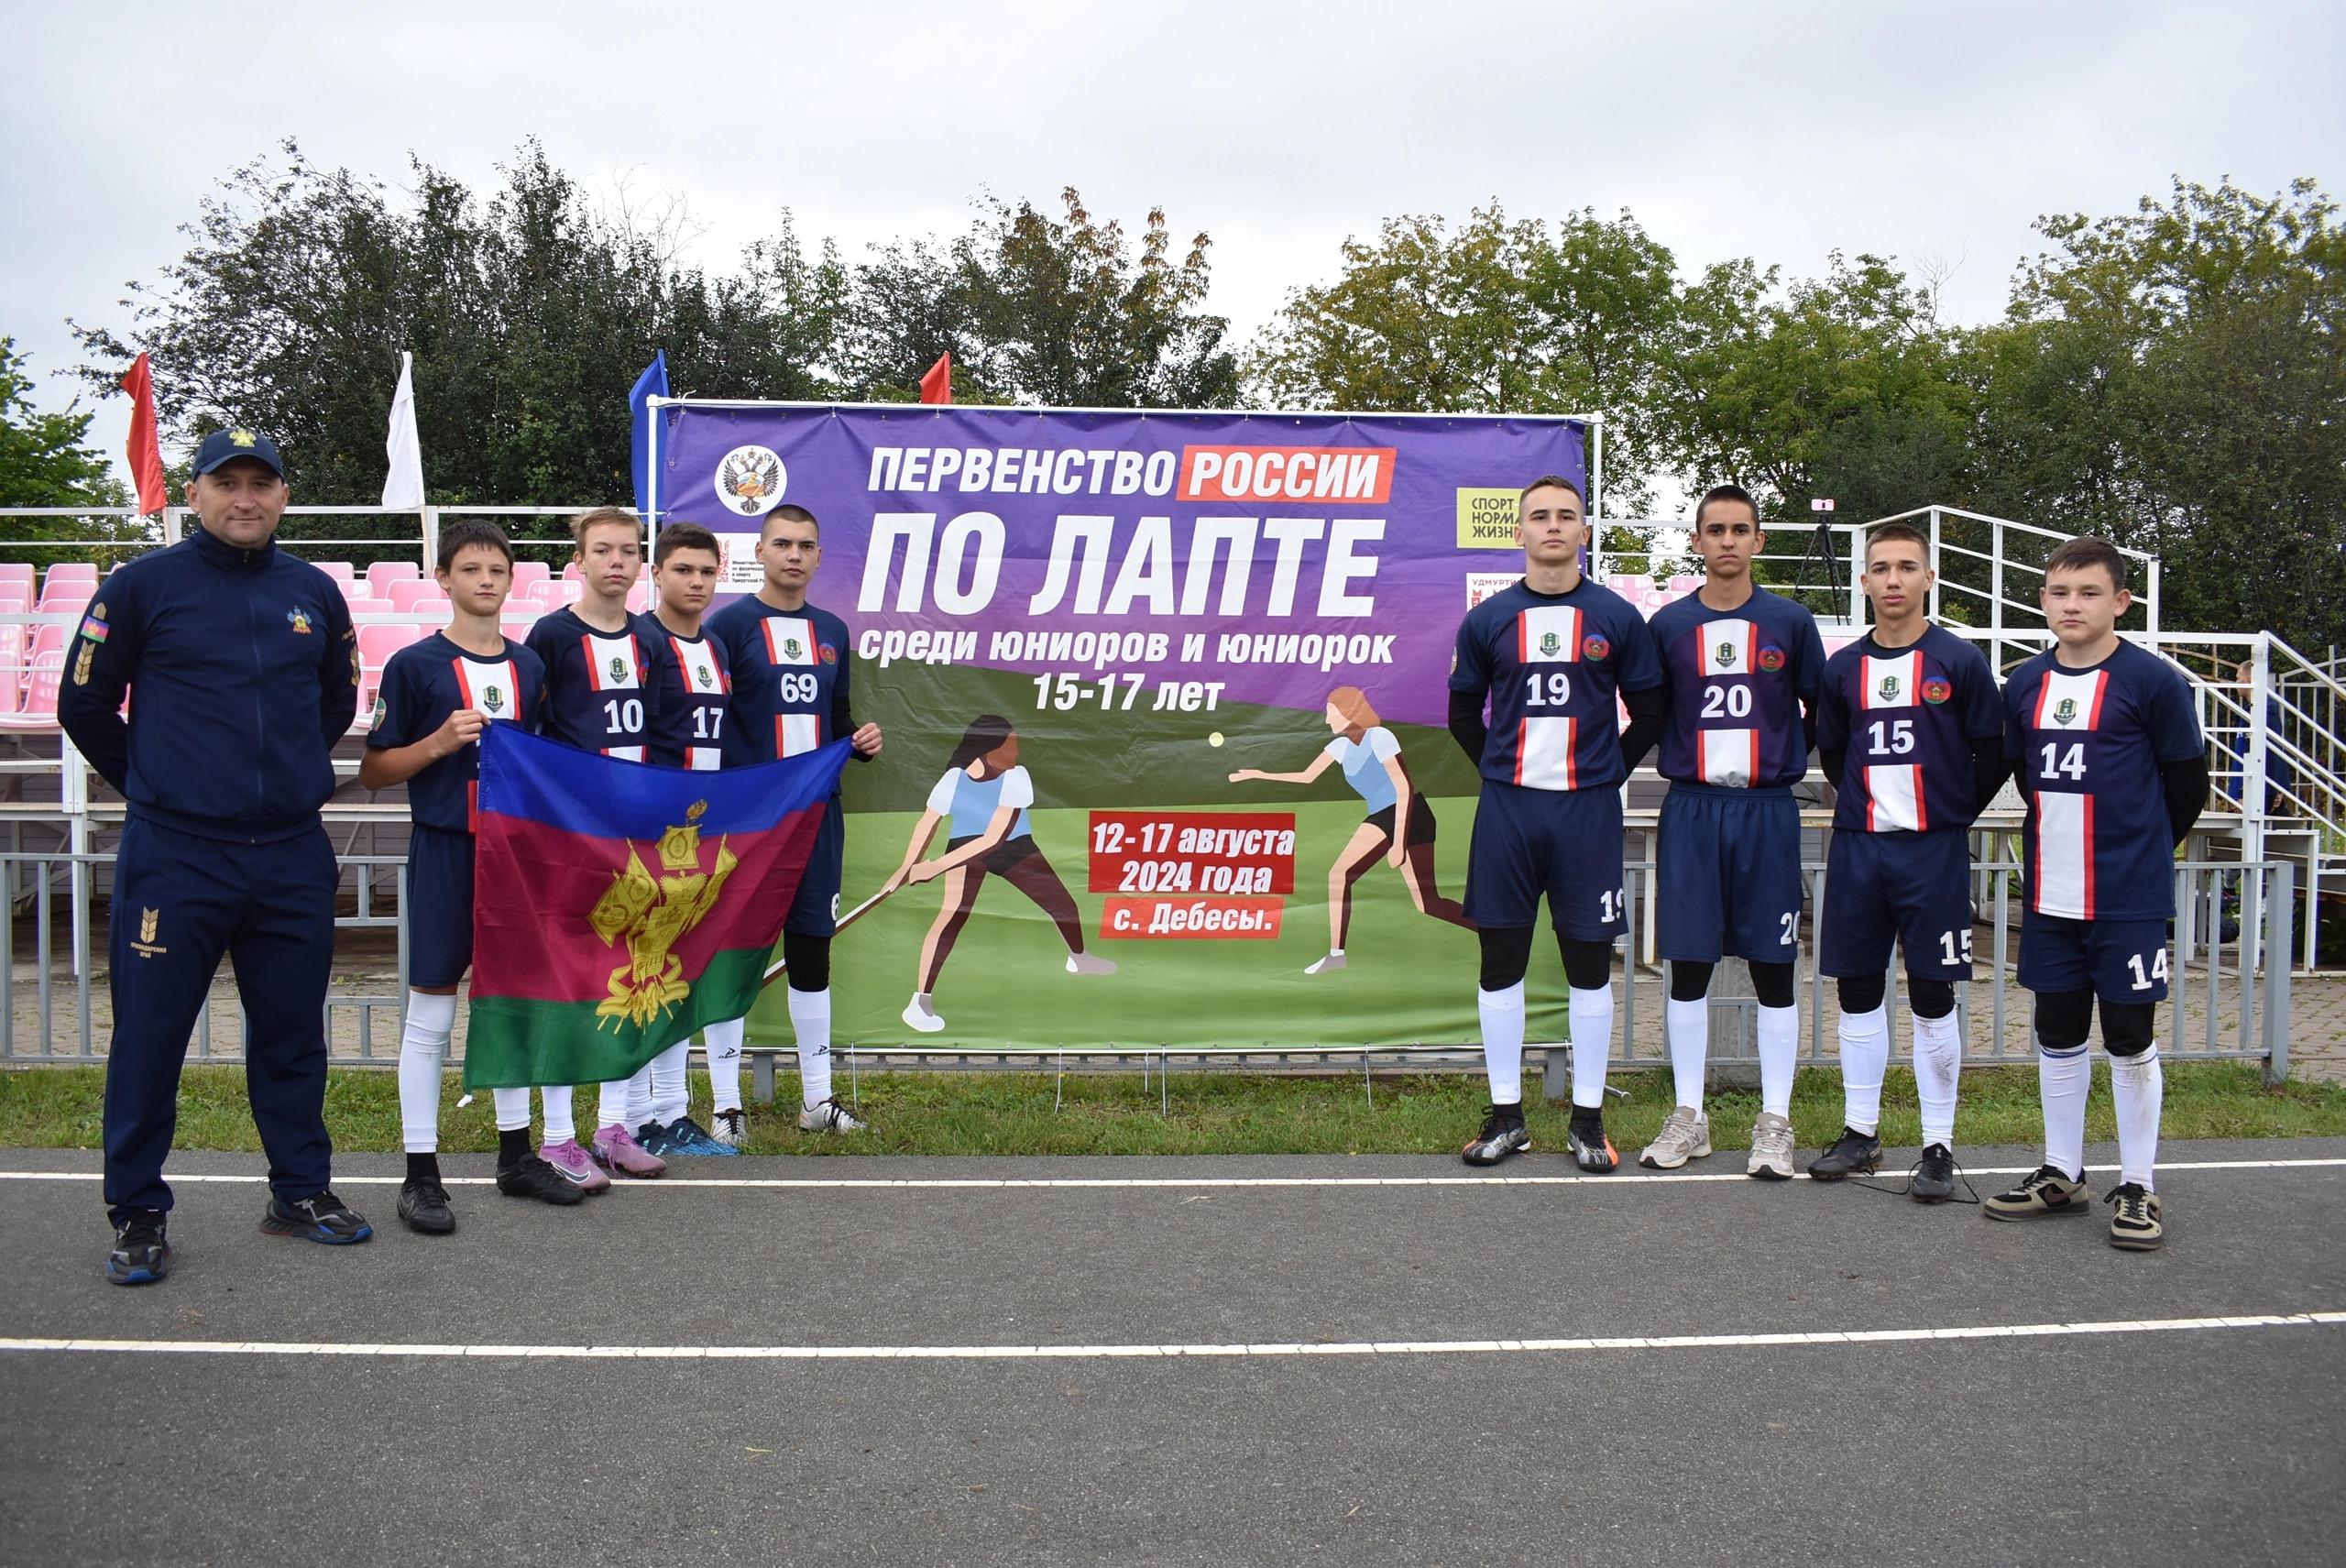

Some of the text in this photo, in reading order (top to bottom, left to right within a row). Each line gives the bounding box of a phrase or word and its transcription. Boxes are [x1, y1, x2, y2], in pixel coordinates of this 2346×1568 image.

[868, 447, 1379, 499] ПЕРВЕНСТВО РОССИИ
[1472, 498, 1515, 510] СПОРТ
[1472, 525, 1513, 538] ЖИЗН
[857, 511, 1387, 617] ПО ЛАПТЕ
[1472, 578, 1517, 587] УДМУРТИ
[858, 629, 1397, 672] среди юниоров и юниорок
[781, 673, 818, 703] 69
[1033, 673, 1225, 711] 15-17 лет
[1526, 673, 1571, 706] 19
[1700, 685, 1752, 718] 20
[604, 699, 643, 733] 10
[692, 707, 724, 739] 17
[1868, 719, 1915, 755] 15
[2040, 742, 2087, 780] 14
[1178, 828, 1295, 857] августа
[1118, 861, 1273, 895] 2024 года
[1113, 901, 1272, 934] с. Дебесы.
[1940, 928, 1972, 965] 15
[2127, 948, 2168, 990] 14
